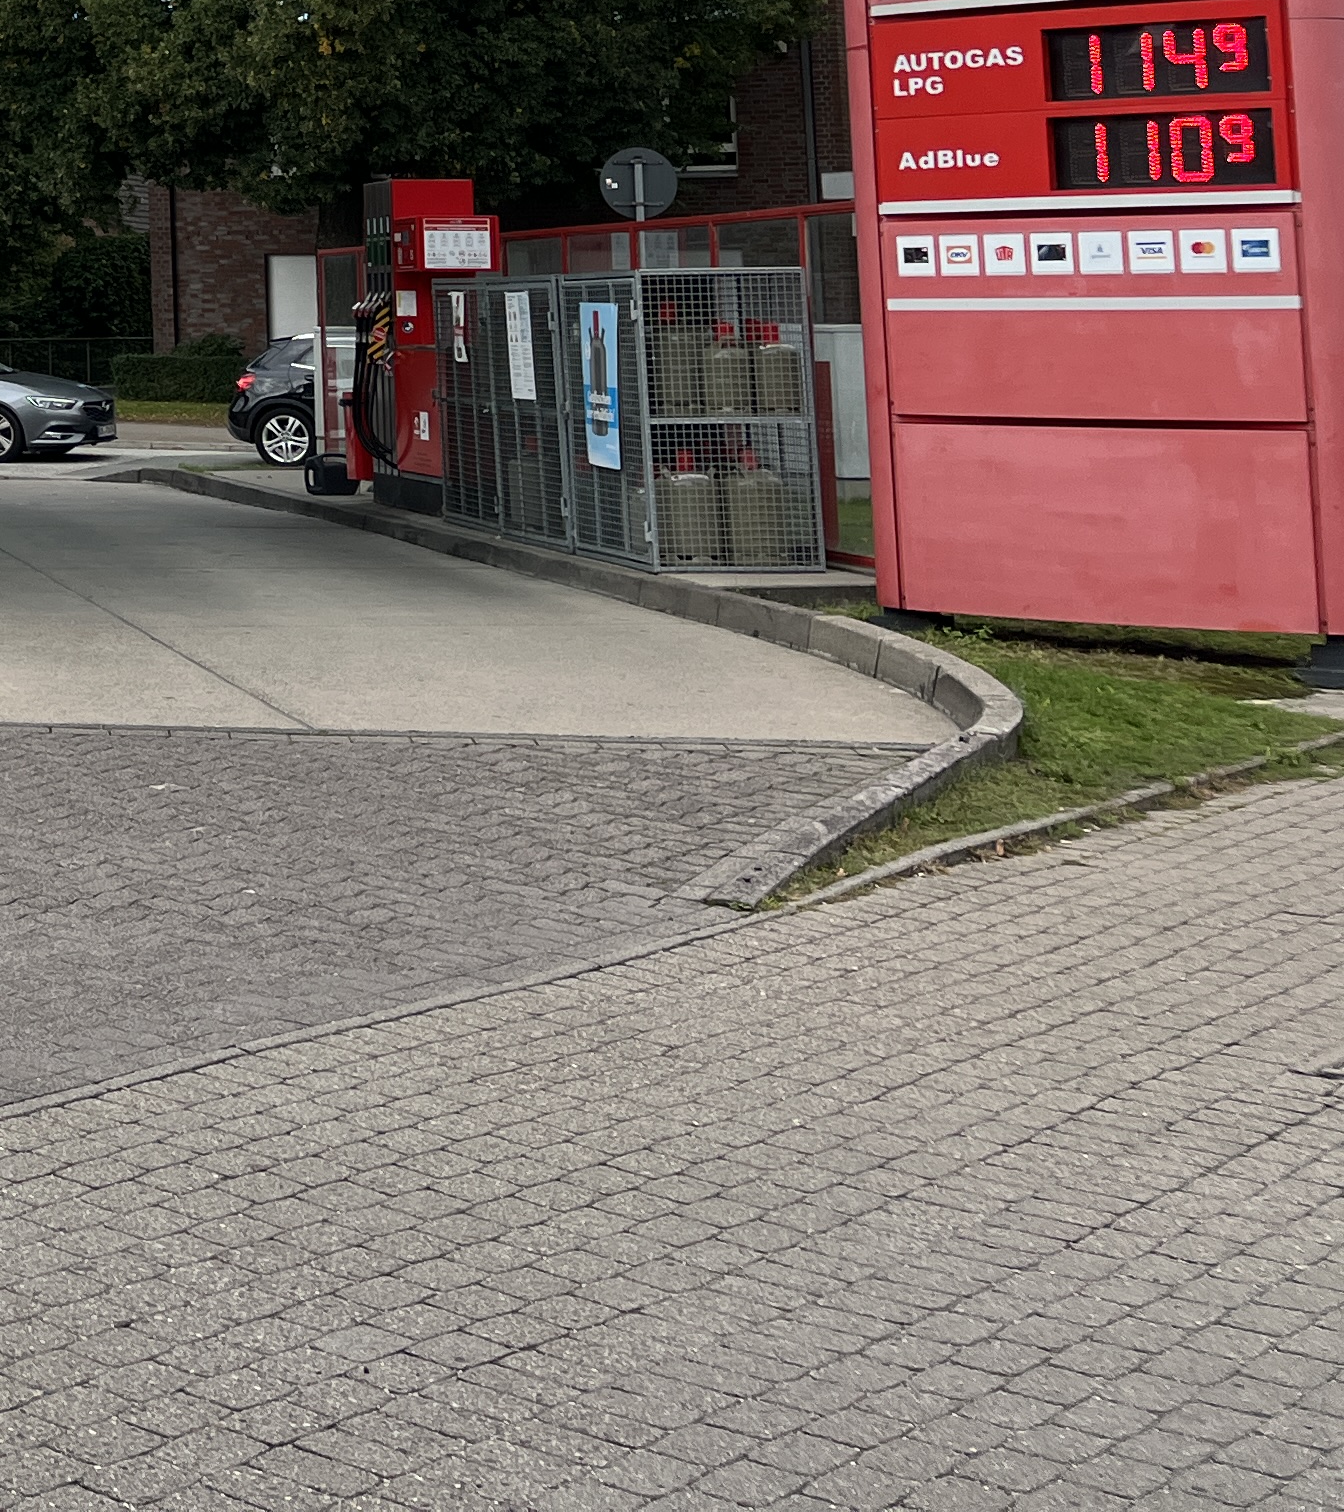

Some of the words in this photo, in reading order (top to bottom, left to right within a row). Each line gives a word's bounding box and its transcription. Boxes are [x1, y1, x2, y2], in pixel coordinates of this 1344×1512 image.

[893, 46, 1024, 74] AUTOGAS
[893, 76, 944, 97] LPG
[898, 149, 1000, 171] AdBlue
[1140, 247, 1164, 255] VISA
